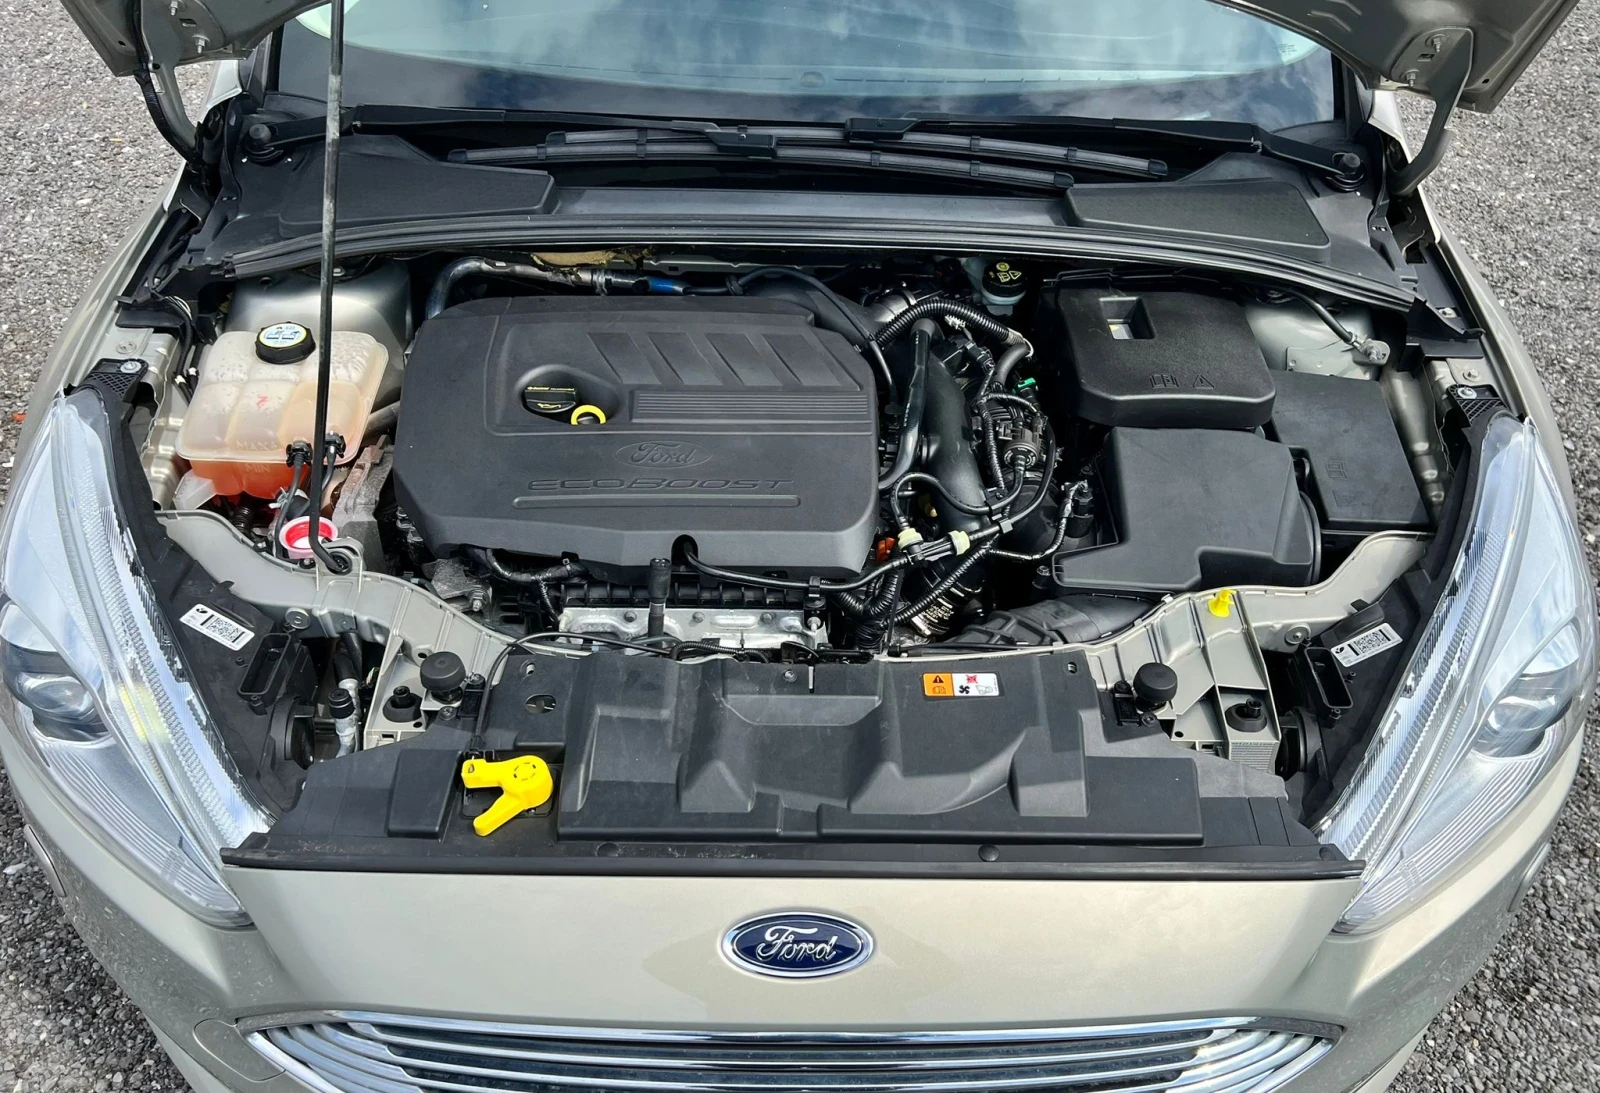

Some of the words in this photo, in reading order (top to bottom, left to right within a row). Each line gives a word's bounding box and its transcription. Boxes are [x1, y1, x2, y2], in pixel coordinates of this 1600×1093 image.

[236, 440, 270, 451] MAX
[631, 441, 695, 463] Ford
[245, 463, 271, 473] MIN
[527, 477, 794, 491] ECOBOOST
[757, 925, 839, 961] Ford
